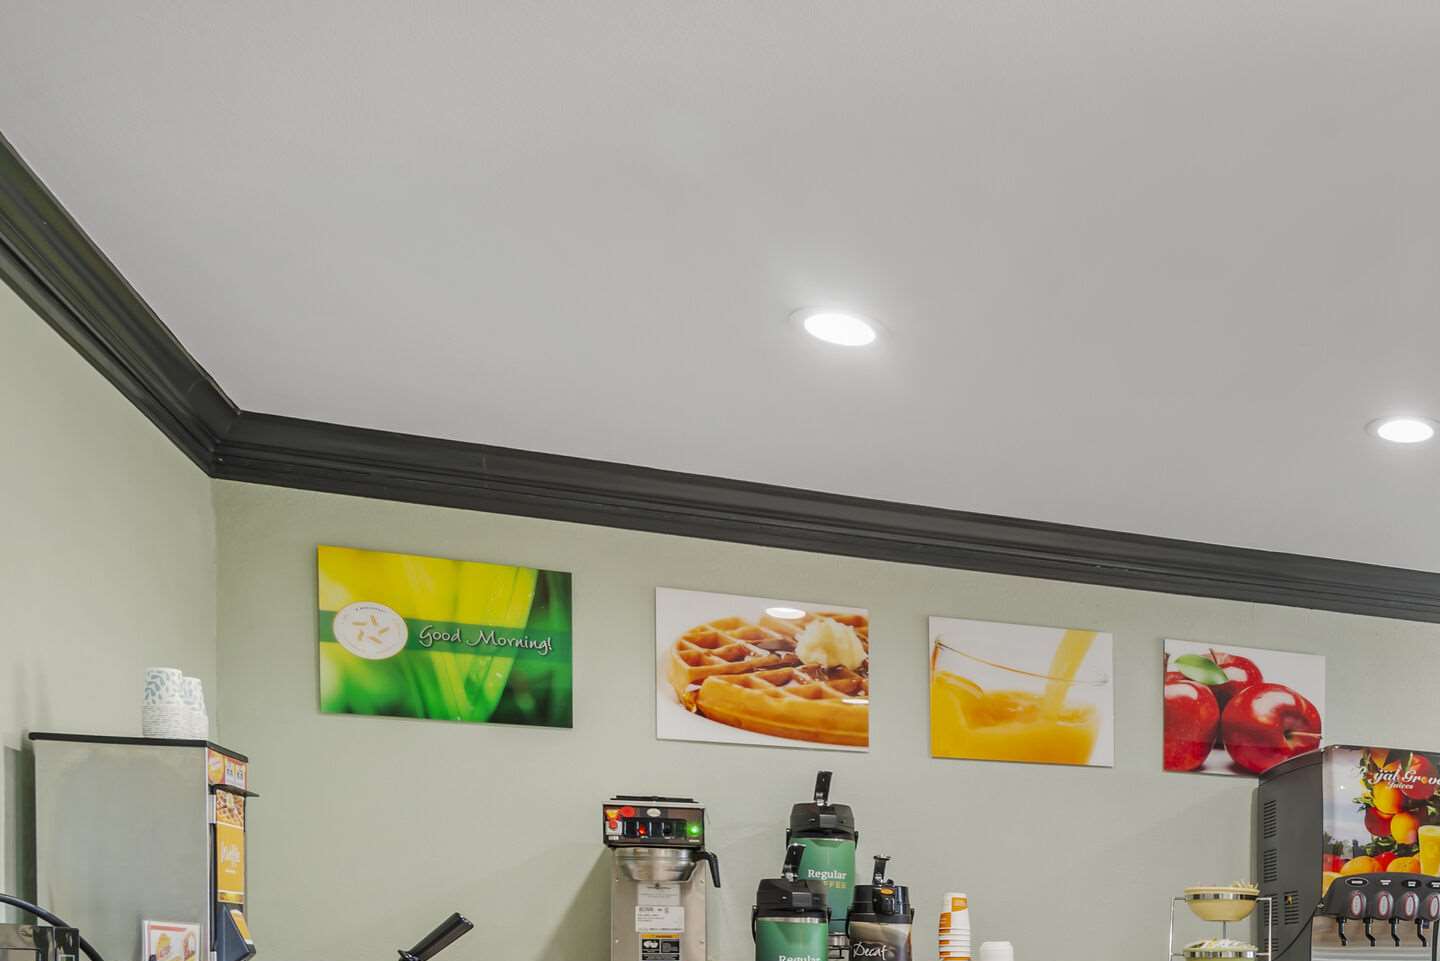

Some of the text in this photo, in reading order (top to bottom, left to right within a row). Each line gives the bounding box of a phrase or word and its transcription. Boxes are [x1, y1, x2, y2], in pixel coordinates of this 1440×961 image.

[419, 624, 552, 656] Good Morning!
[808, 869, 848, 880] Regular
[823, 881, 848, 889] FFEE
[853, 941, 888, 961] Decaf
